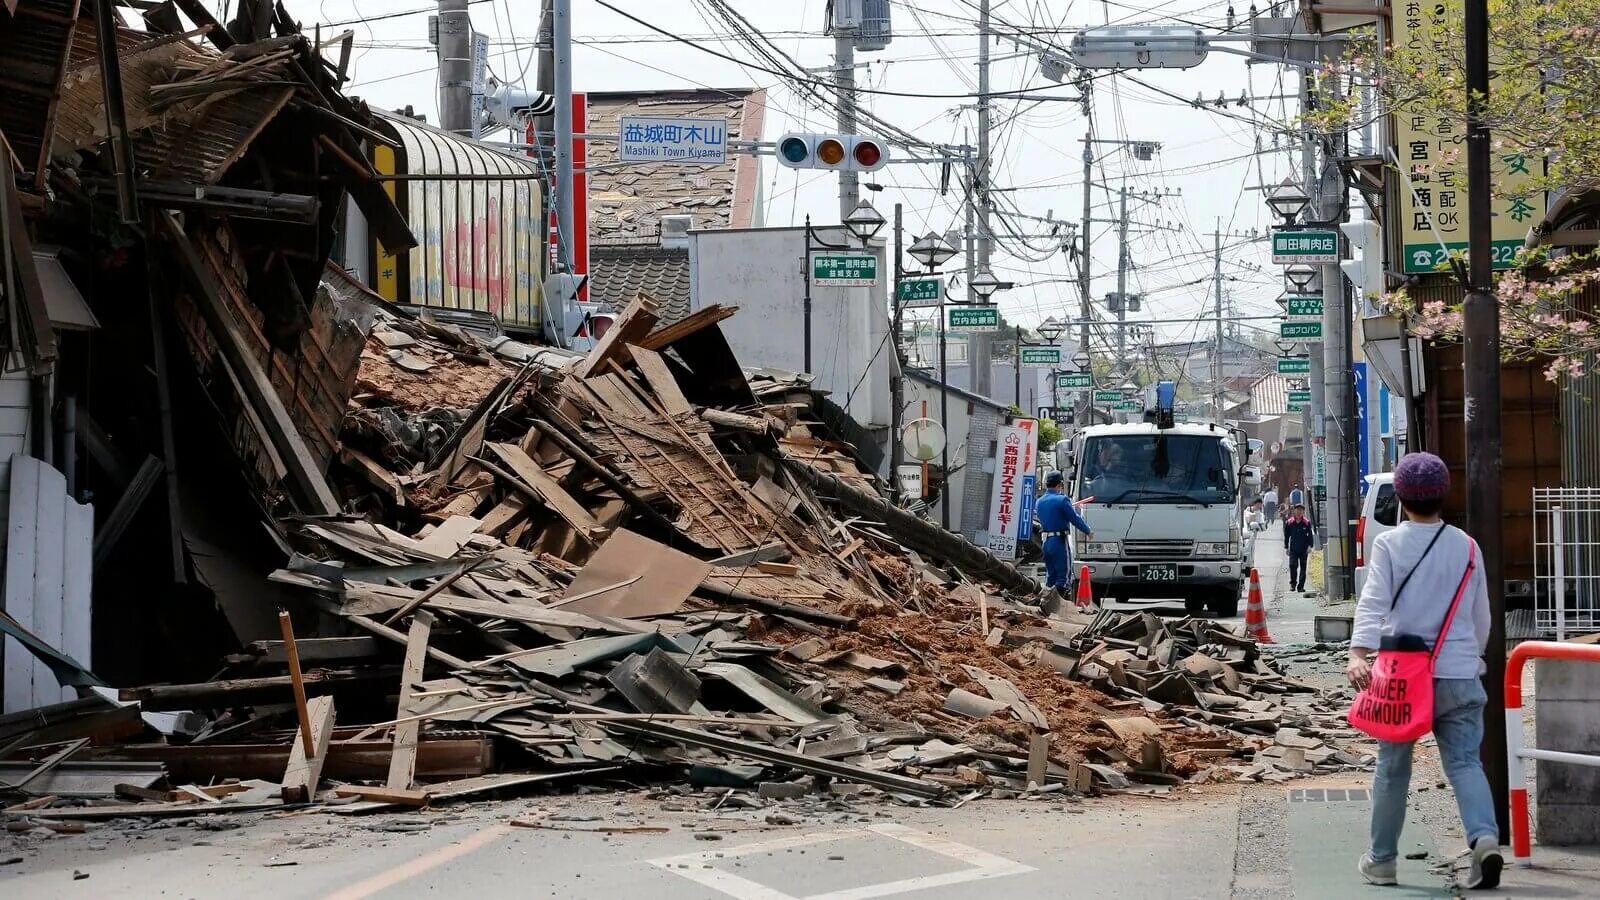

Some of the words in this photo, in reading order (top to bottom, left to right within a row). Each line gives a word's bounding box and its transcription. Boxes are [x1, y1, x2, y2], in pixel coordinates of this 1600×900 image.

[624, 124, 721, 144] 益城町木山
[625, 146, 658, 156] Mashiki
[663, 147, 685, 157] Town
[688, 147, 721, 159] Kiyama
[998, 445, 1018, 534] 西部ガスエネルギー
[1023, 482, 1034, 536] ホーロー
[989, 542, 1014, 552] ヒロタ
[1146, 569, 1175, 580] 20-28
[1367, 677, 1408, 702] UNDER
[1356, 697, 1412, 726] ARMOUR
